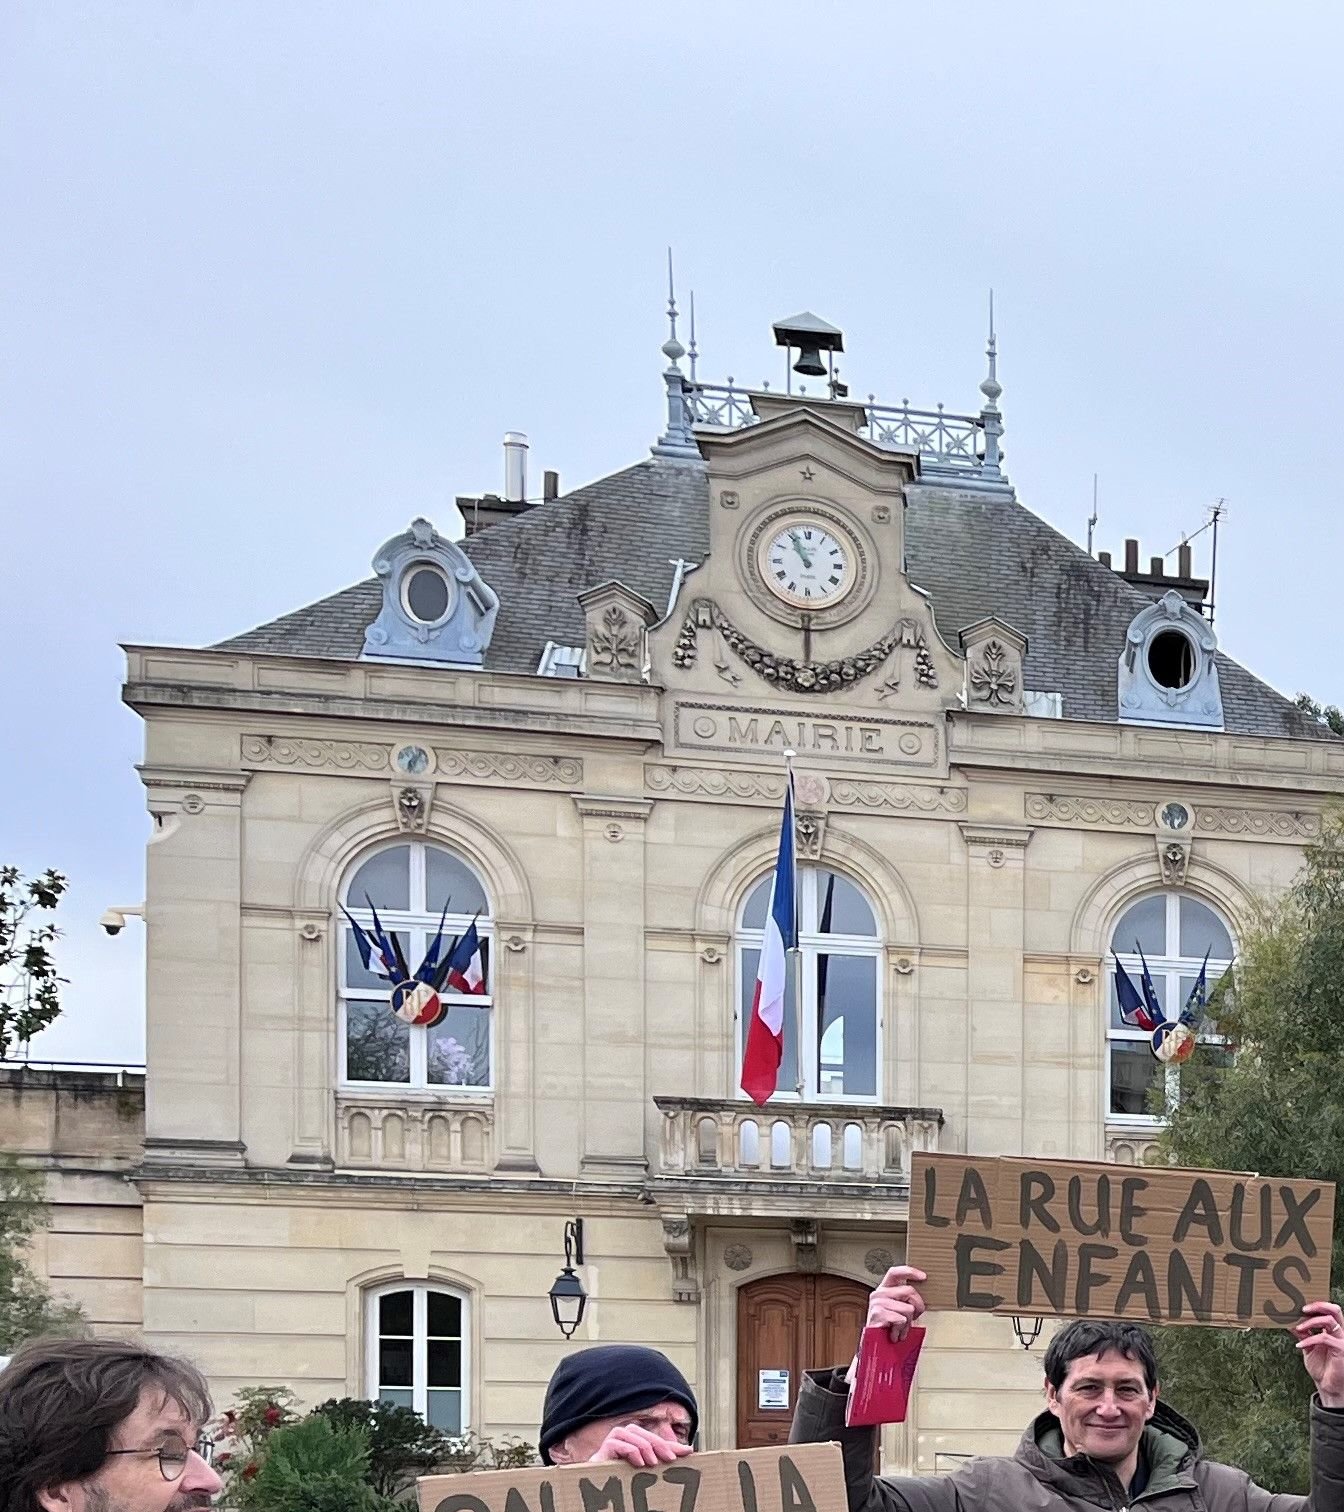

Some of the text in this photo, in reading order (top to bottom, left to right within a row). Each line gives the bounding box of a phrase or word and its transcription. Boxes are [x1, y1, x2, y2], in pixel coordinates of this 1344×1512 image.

[728, 717, 883, 754] MAIRIE
[924, 1166, 1321, 1257] LA RUE AUX
[955, 1233, 1311, 1325] ENFANTS
